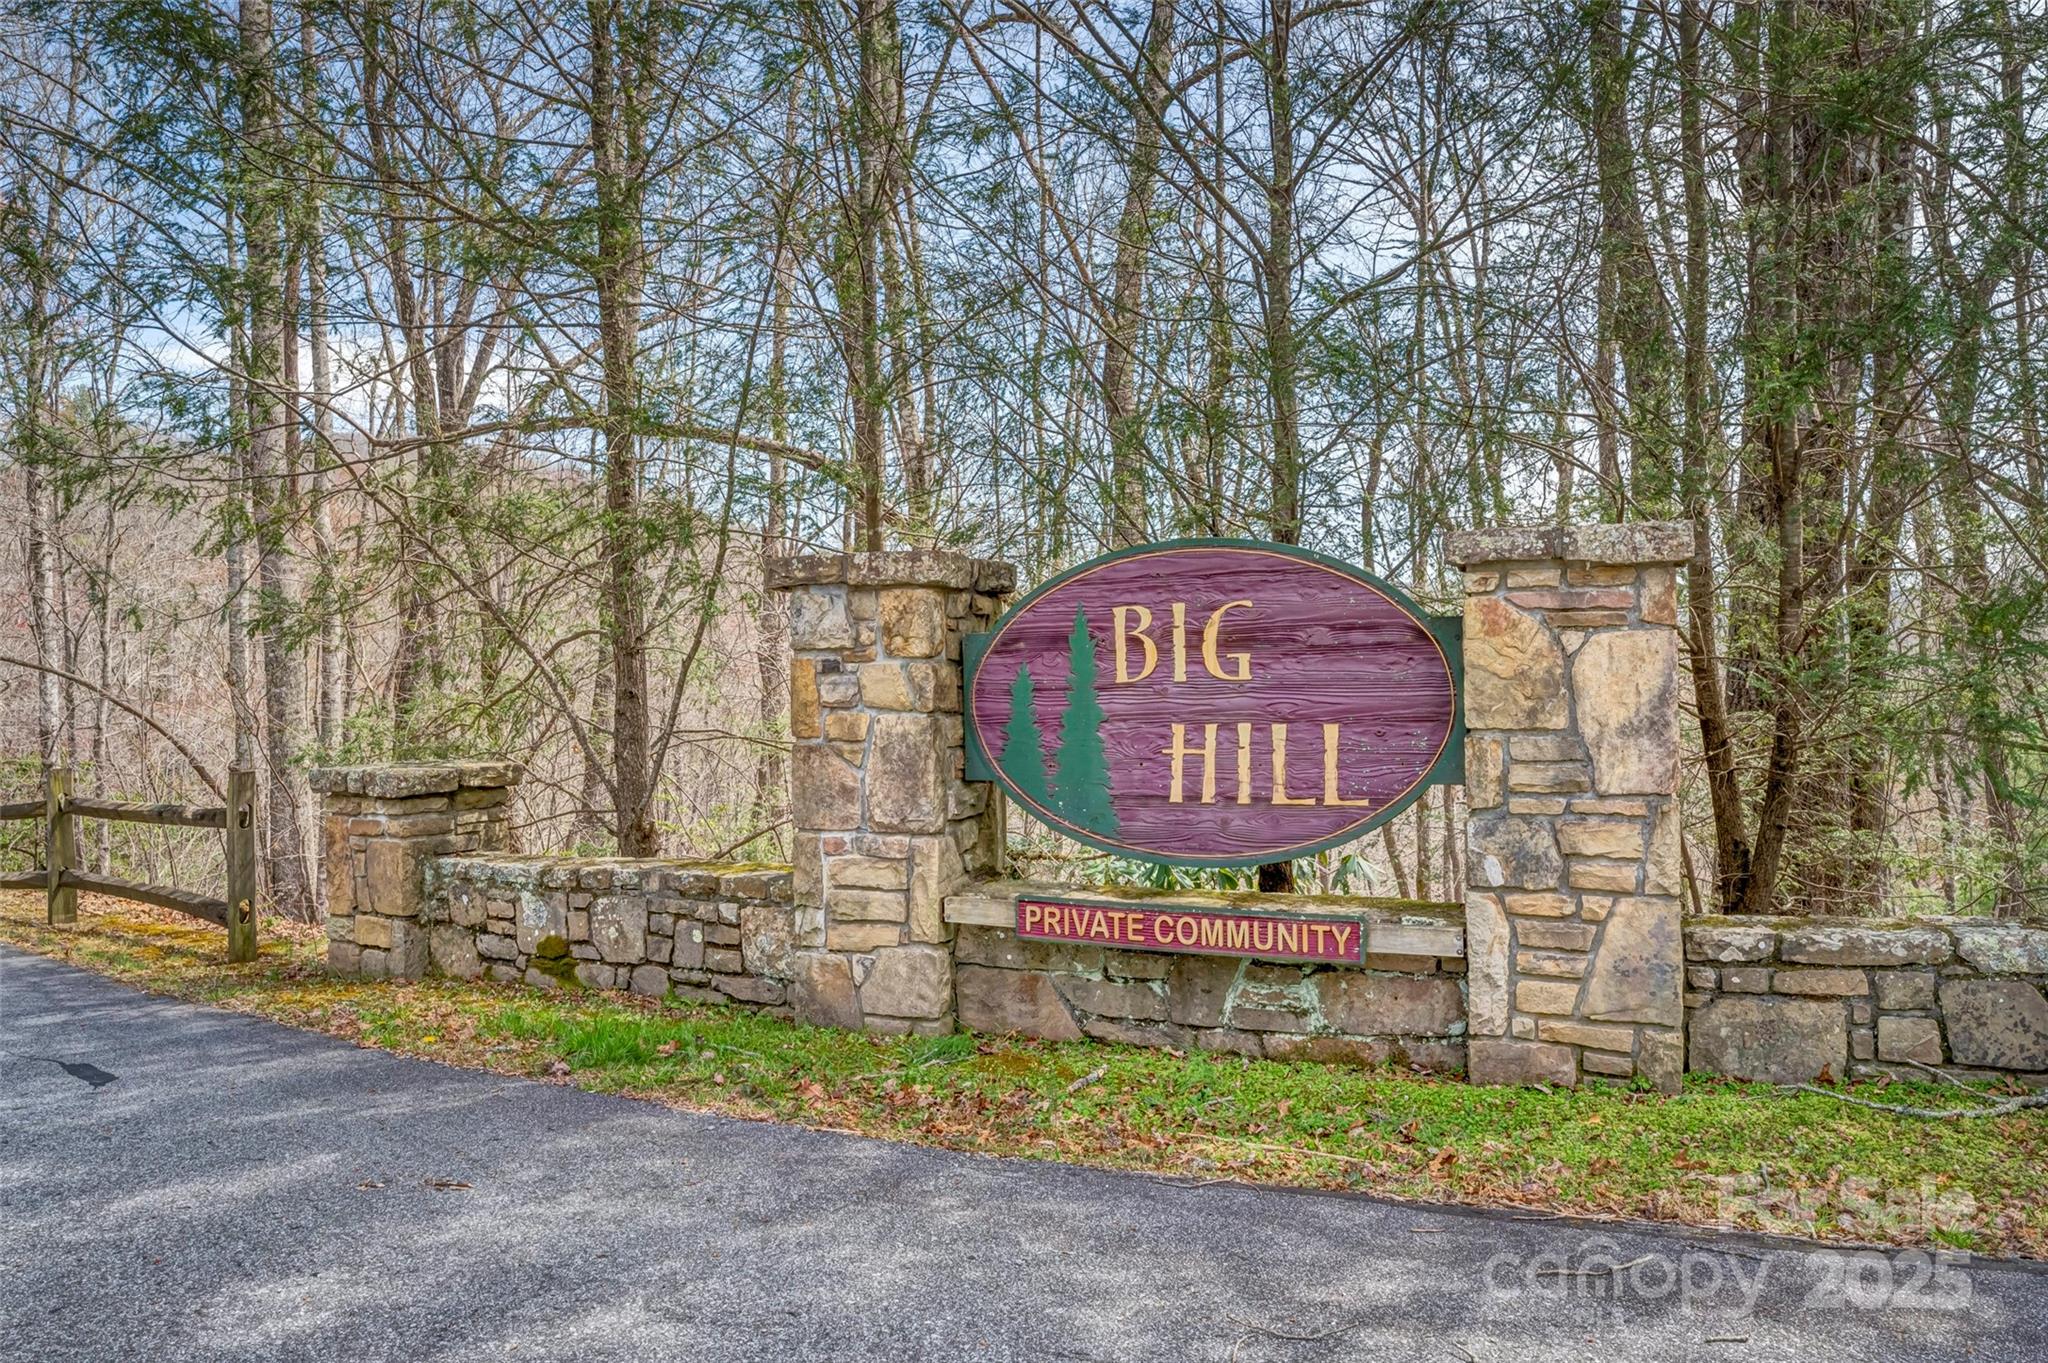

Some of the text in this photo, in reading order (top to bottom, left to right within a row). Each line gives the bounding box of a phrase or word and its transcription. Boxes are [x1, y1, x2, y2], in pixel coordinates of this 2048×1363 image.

[1113, 599, 1253, 683] BIG
[1162, 722, 1370, 807] HILL
[1025, 905, 1352, 955] PRIVATE COMMUNITY
